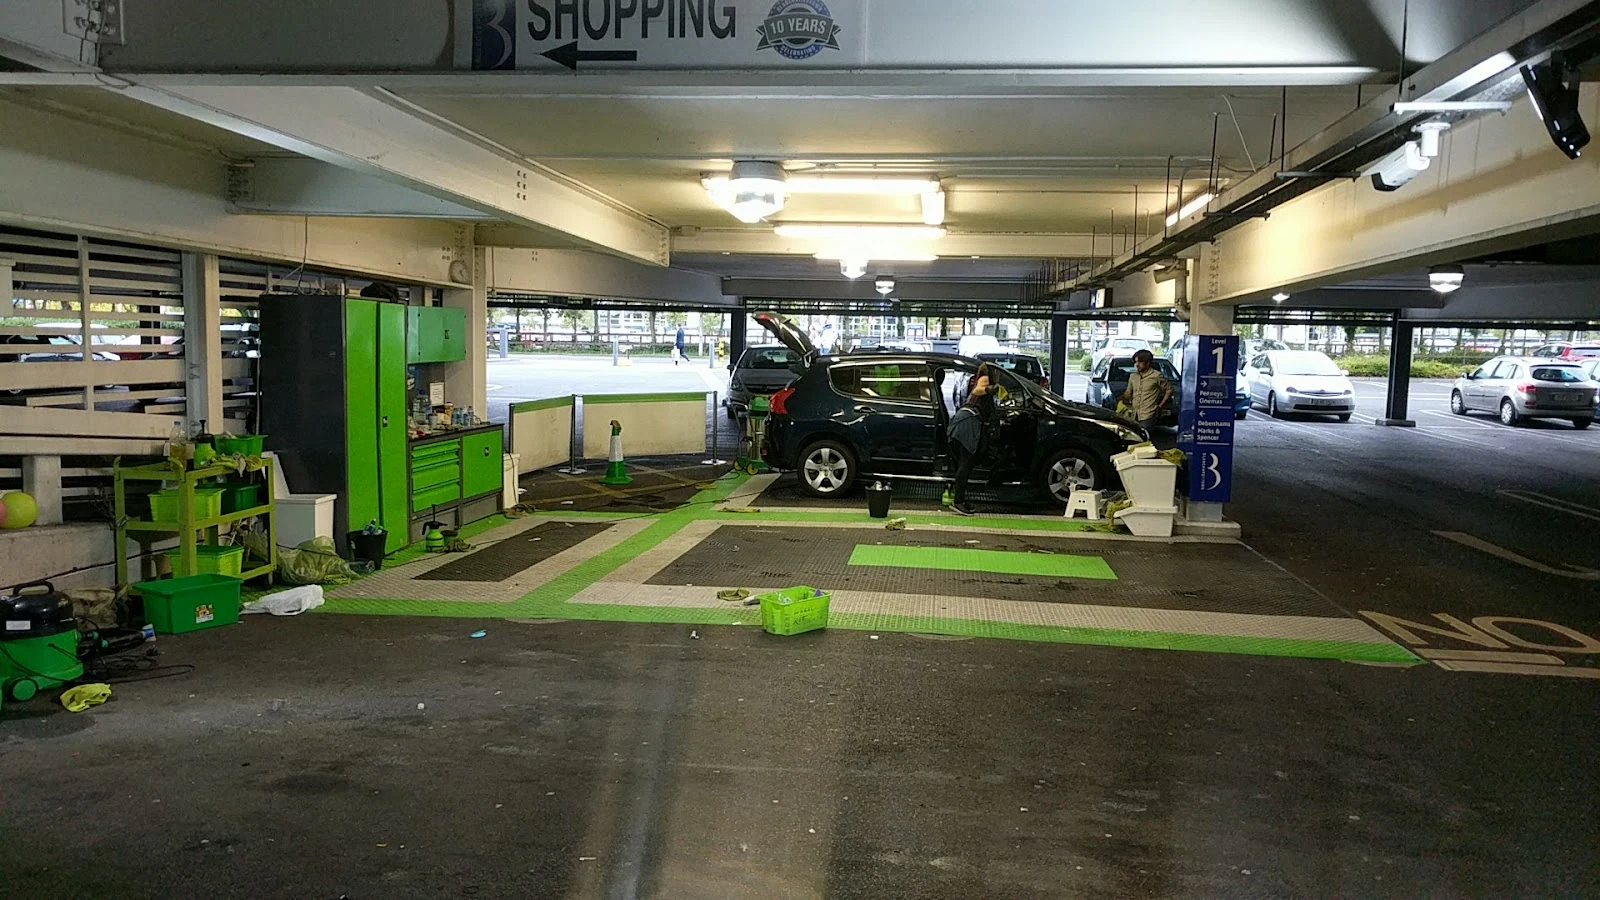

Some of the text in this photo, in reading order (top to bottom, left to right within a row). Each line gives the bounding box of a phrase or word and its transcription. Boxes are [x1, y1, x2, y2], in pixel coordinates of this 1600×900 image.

[527, 0, 736, 41] SHOPPING
[770, 18, 827, 34] 10 YEARS
[1211, 346, 1223, 374] 1
